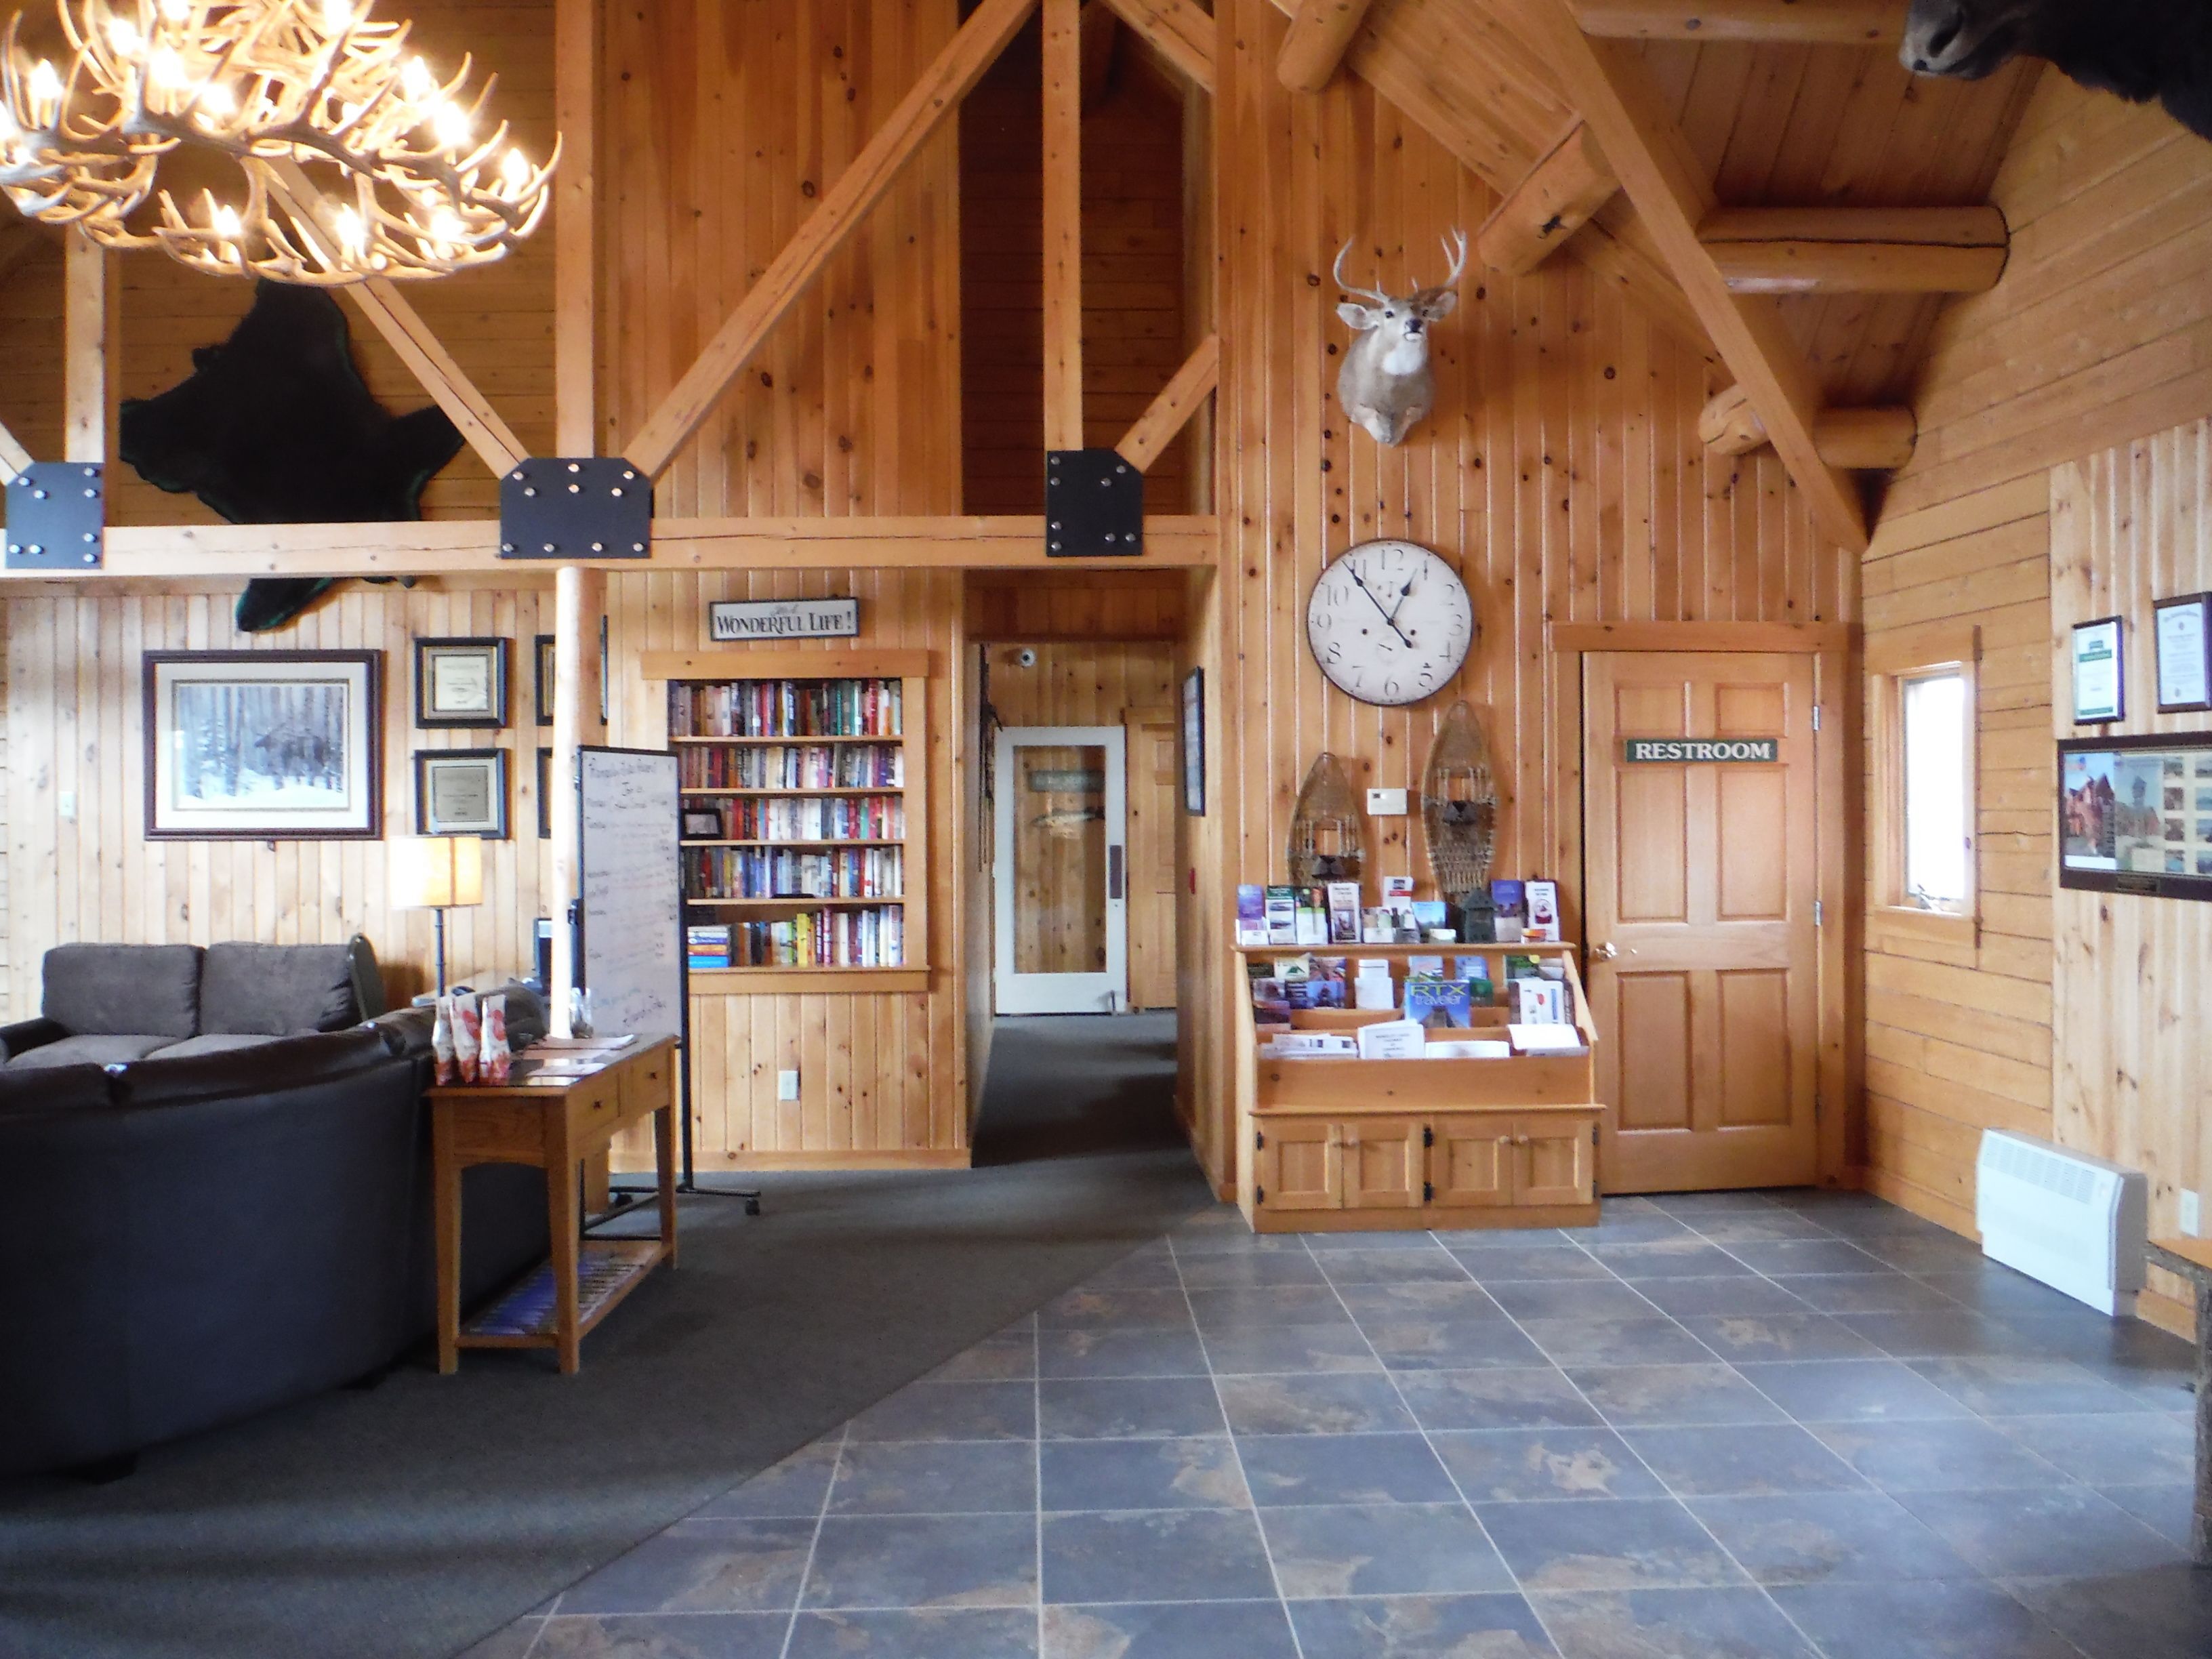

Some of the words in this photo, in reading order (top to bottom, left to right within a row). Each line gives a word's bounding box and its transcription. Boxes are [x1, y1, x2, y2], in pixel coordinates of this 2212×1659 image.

[1381, 549, 1405, 571] 12
[1326, 585, 1349, 607] 10
[716, 614, 802, 634] WONDERFUL
[1315, 612, 1332, 630] 9
[1448, 614, 1464, 636] 3
[1384, 675, 1399, 696] 6
[1635, 742, 1771, 760] RESTROOM
[1411, 985, 1467, 997] RTX
